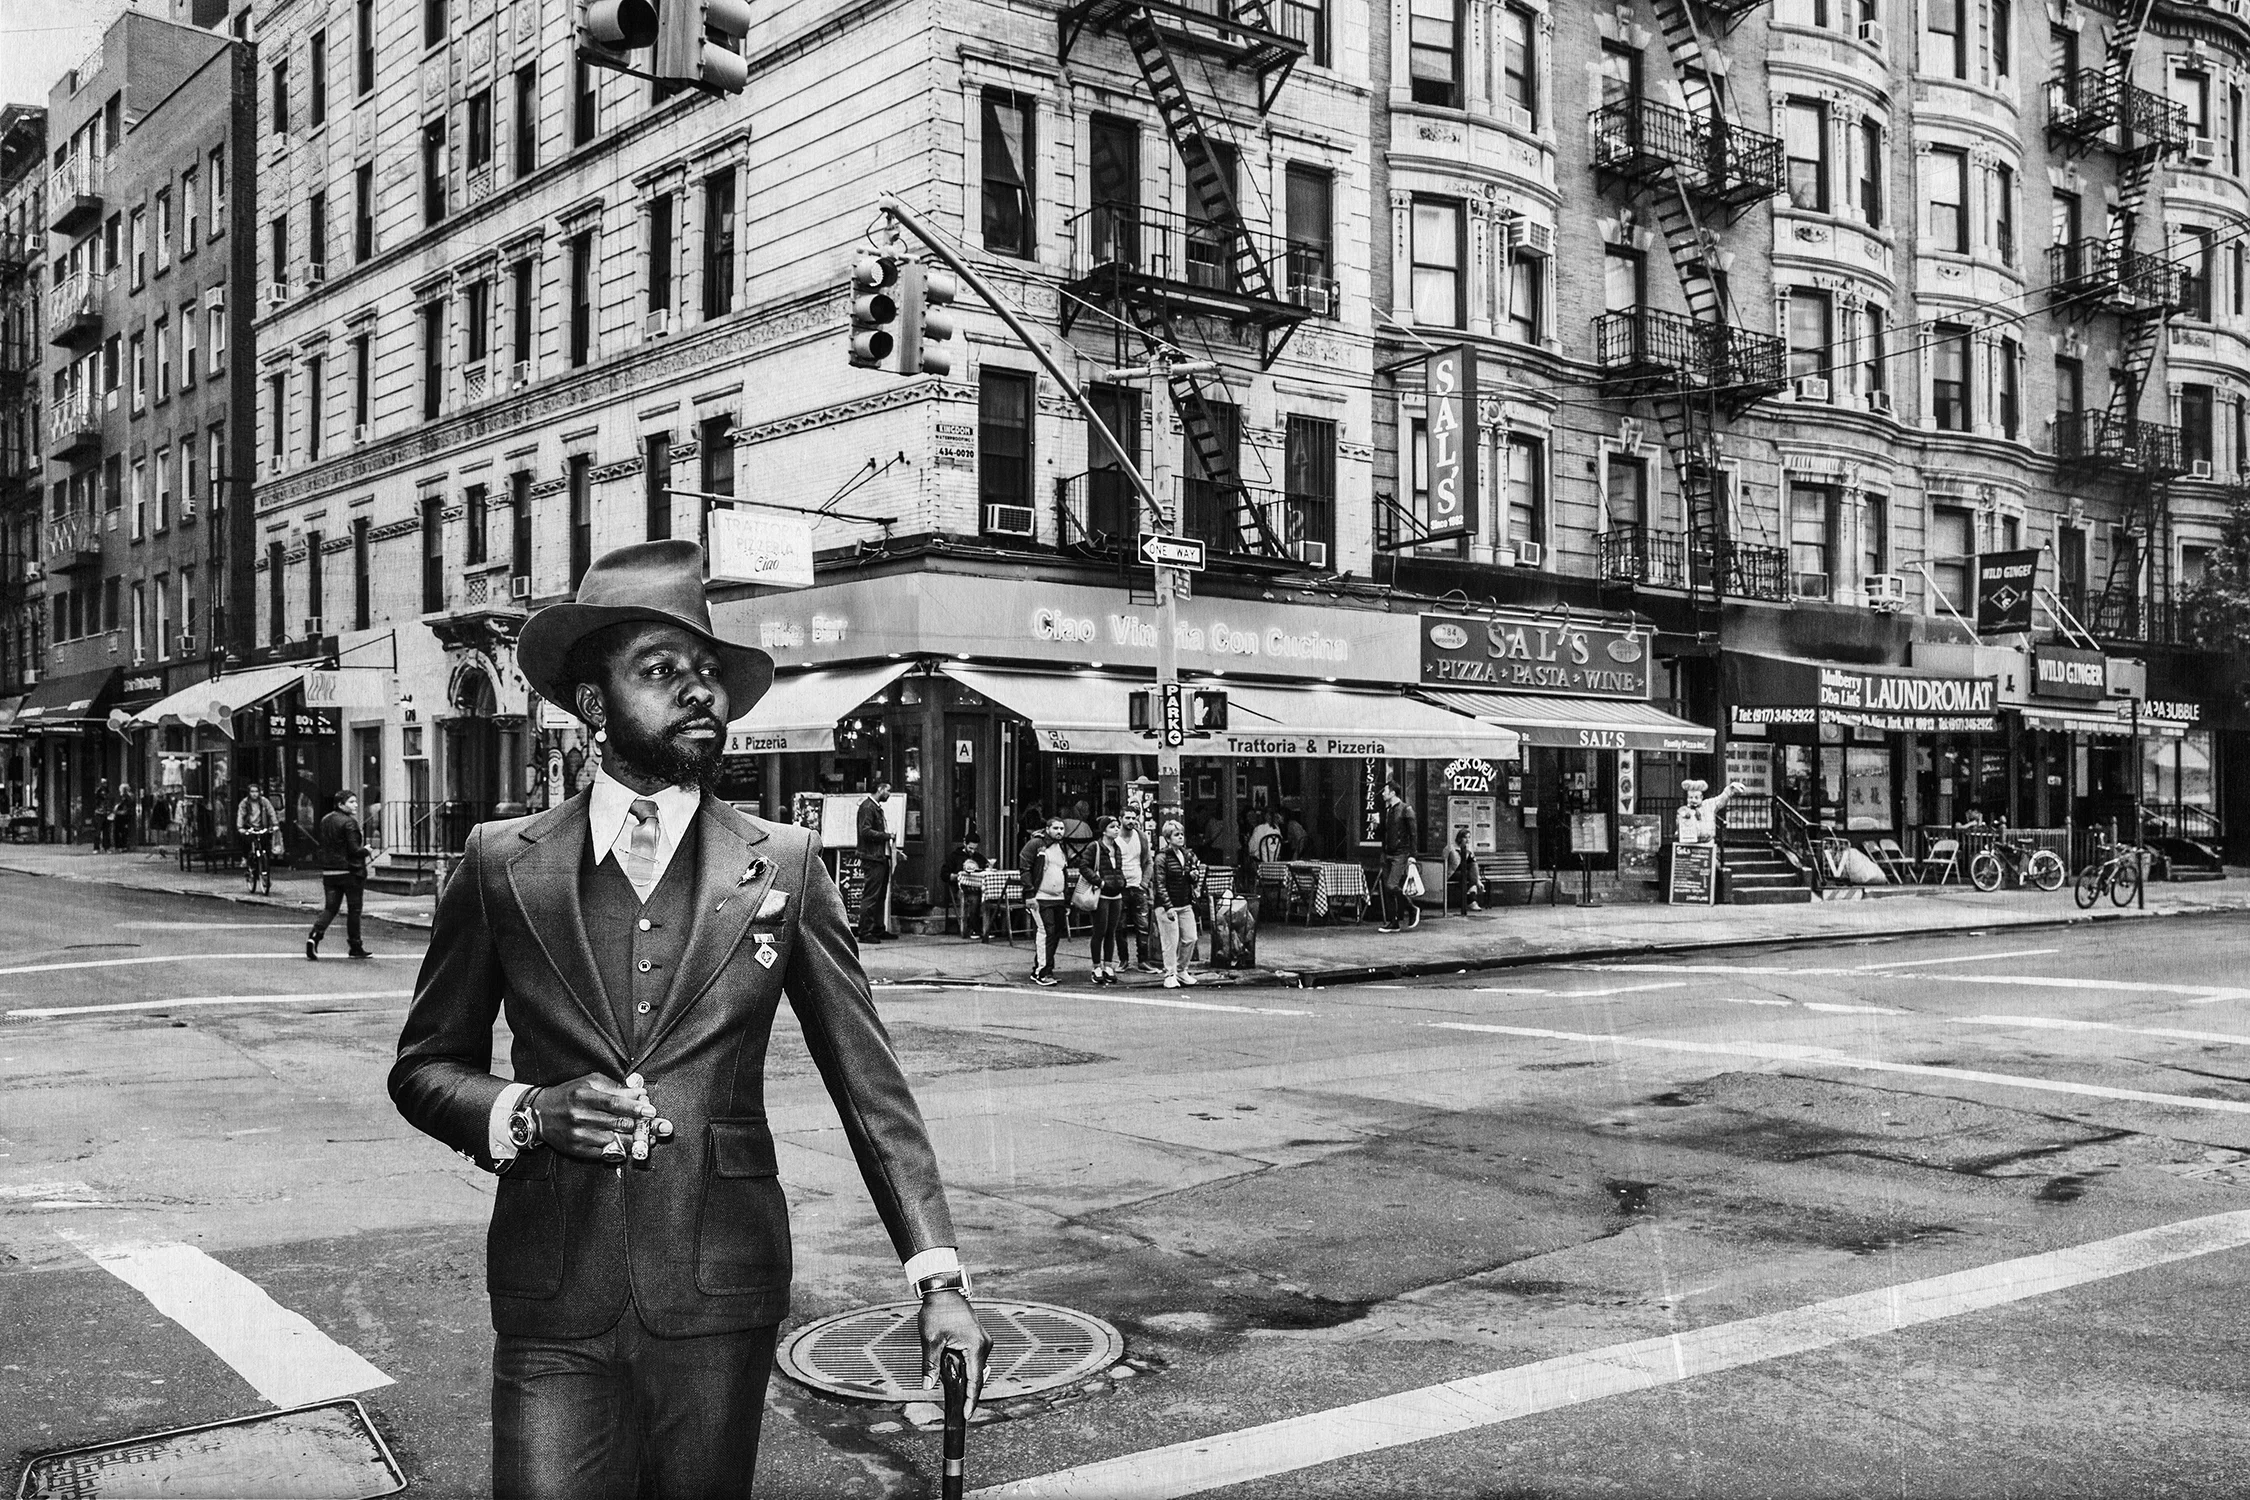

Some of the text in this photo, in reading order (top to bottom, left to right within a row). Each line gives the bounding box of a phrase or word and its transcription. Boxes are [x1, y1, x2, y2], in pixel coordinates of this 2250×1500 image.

[939, 425, 970, 435] KINGDOM
[1433, 359, 1459, 514] SAL'S
[725, 517, 803, 537] TRATTORIA
[736, 537, 793, 555] PIZZERIA
[1149, 543, 1196, 560] ONE WAY
[755, 556, 780, 573] Ciao
[1982, 564, 2033, 580] WILD GINGER
[1032, 607, 1350, 662] Ciao Vinria Con Cucina
[1487, 627, 1590, 665] SAL'S
[1436, 658, 1635, 692] PIZZA PASTA WINE
[1821, 668, 1862, 693] Mulberry
[2037, 658, 2104, 687] WILD GINGER
[1821, 686, 1840, 705] Dba
[1865, 676, 1993, 711] LAUNDROMAT
[1166, 684, 1181, 731] PARK
[1752, 708, 1774, 723] (917)
[2143, 699, 2200, 721] APABUBBLE
[731, 735, 788, 751] & Pizzeria
[1227, 738, 1385, 755] Trattoria & Pizzeria
[1579, 729, 1626, 748] SAL'S
[959, 743, 970, 758] A
[1443, 758, 1472, 780] BRICK
[1472, 758, 1497, 782] OVEN
[1365, 757, 1376, 810] OYSTER
[1453, 775, 1489, 792] PIZZA
